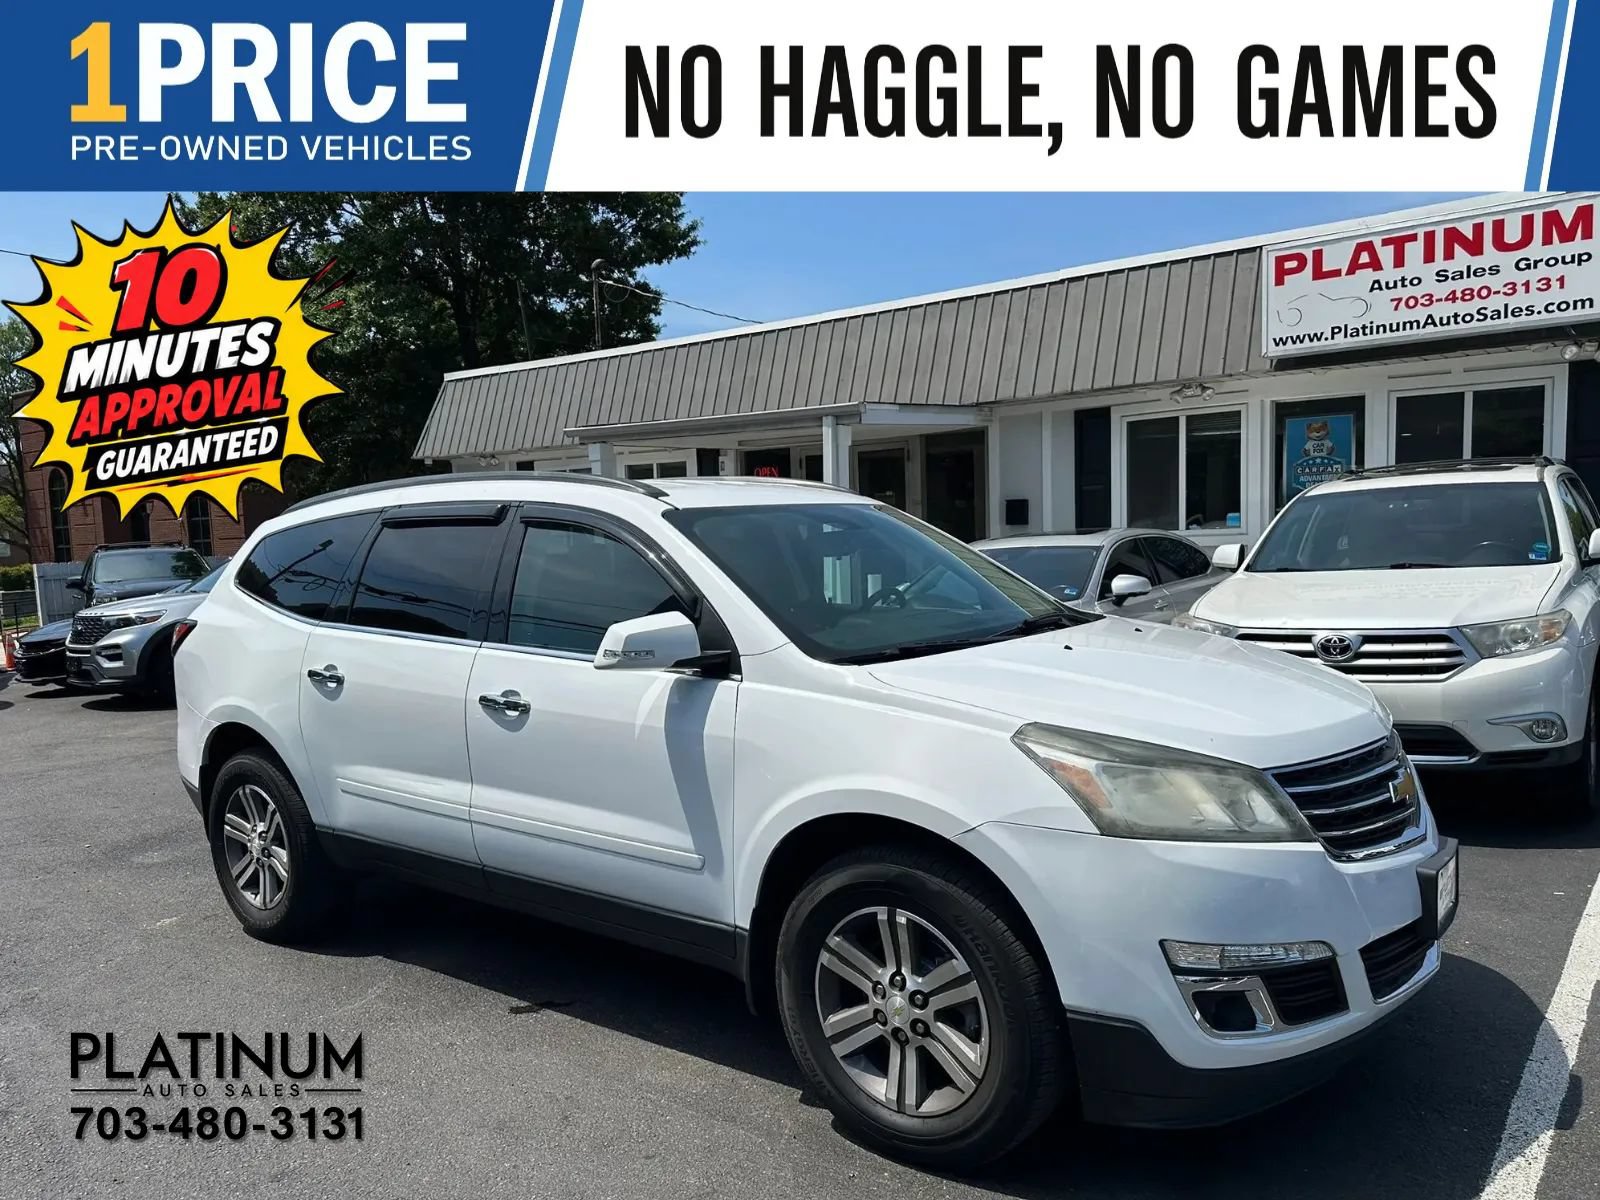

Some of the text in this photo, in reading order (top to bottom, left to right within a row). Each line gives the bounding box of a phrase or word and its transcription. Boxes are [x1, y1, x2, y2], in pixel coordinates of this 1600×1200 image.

[1274, 204, 1594, 287] PLATINUM
[1369, 251, 1593, 293] Auto Sales Group
[1390, 275, 1565, 312] 703-480-3131
[1272, 297, 1594, 347] www.PlatinumAutoSales.com
[754, 465, 779, 478] OPEN
[1297, 464, 1342, 473] CARFAX
